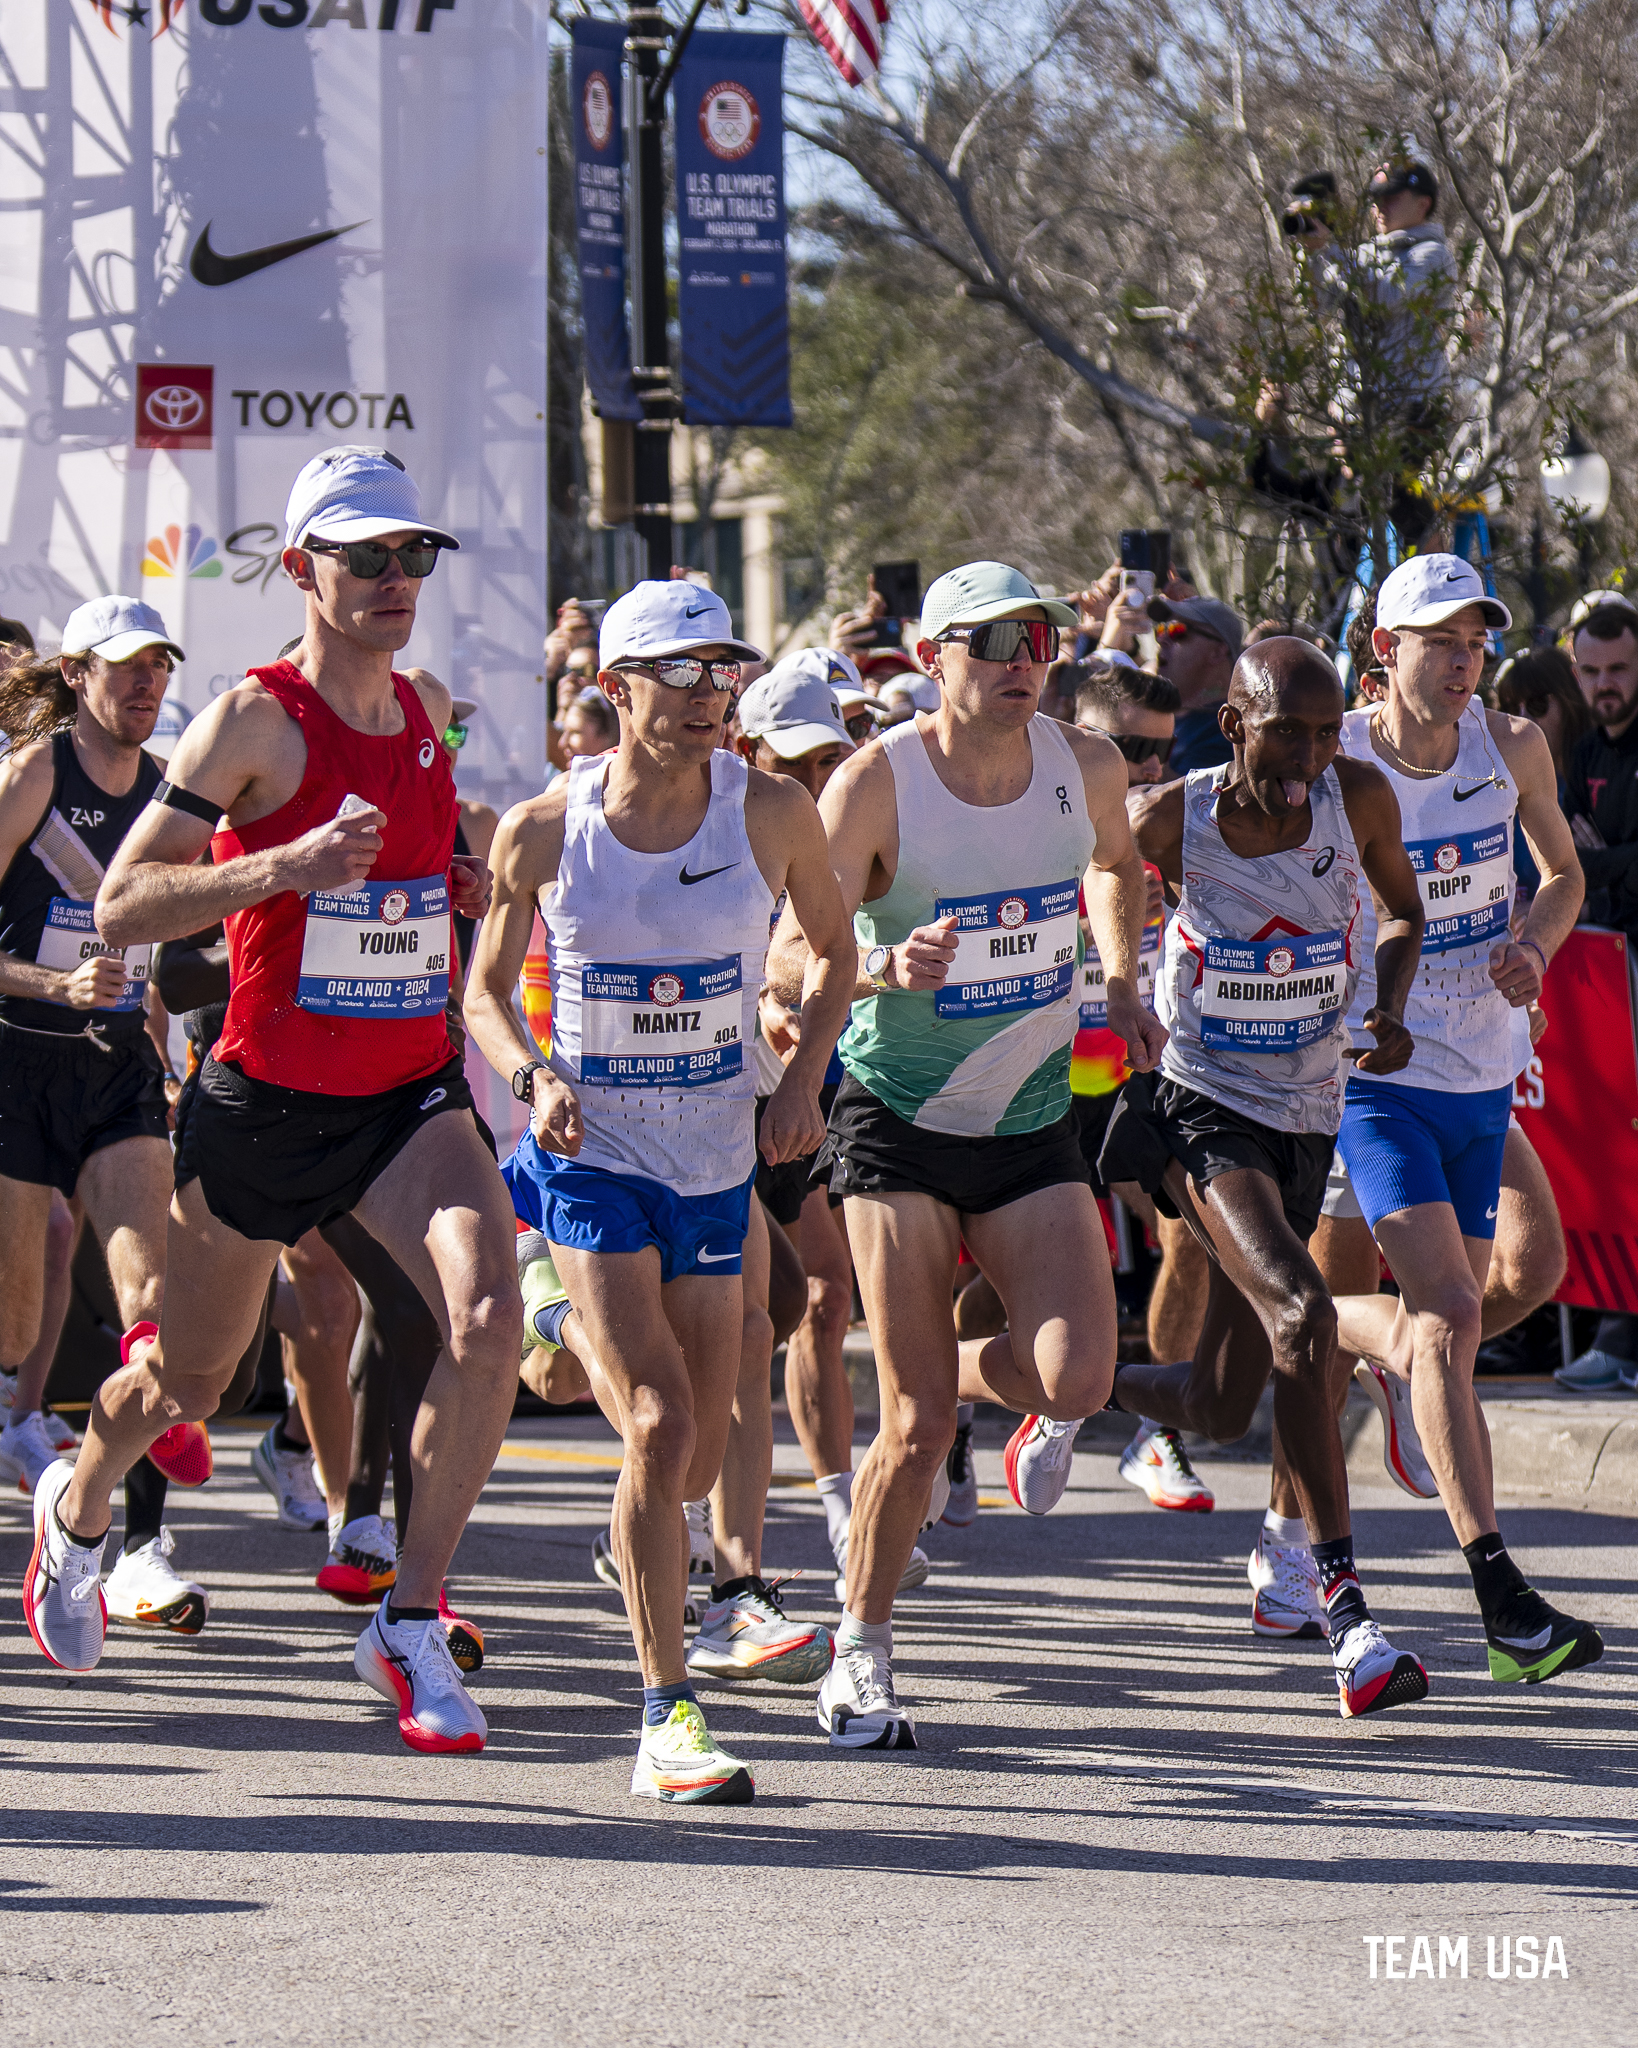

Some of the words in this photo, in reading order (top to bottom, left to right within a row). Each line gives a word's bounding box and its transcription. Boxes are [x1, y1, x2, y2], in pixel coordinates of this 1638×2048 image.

[686, 173, 713, 194] U.S.
[716, 173, 777, 196] OLYMPIC
[686, 196, 724, 218] TEAM
[728, 197, 777, 219] TRIALS
[705, 221, 758, 237] MARATHON
[231, 389, 415, 430] TOYOTA
[70, 806, 106, 828] ZAP
[1473, 832, 1504, 851] MARATHON
[421, 887, 447, 903] MARATHON
[1427, 874, 1472, 900] RUPP
[1488, 884, 1505, 901] 401
[314, 899, 339, 912] TEAM
[340, 902, 370, 915] TRIALS
[1041, 889, 1076, 907] MARATHON
[52, 905, 65, 916] U.S.
[66, 907, 93, 918] OLYMPIC
[940, 908, 954, 917] U.S.
[955, 904, 988, 916] OLYMPIC
[1470, 907, 1494, 927] 2024
[50, 914, 69, 926] TEAM
[69, 917, 92, 928] TRIALS
[962, 915, 988, 926] TRIALS
[359, 930, 419, 955] YOUNG
[989, 932, 1038, 959] RILEY
[1208, 945, 1222, 957] U.S.
[1223, 948, 1255, 959] OLYMPIC
[1306, 940, 1342, 956] MARATHON
[425, 953, 446, 972] 405
[1053, 945, 1073, 964] 402
[1208, 956, 1228, 967] TEAM
[1229, 959, 1255, 969] TRIALS
[132, 964, 145, 978] 421
[586, 972, 602, 983] U.S.
[603, 973, 638, 985] OLYMPIC
[699, 968, 738, 986] MARATHON
[327, 980, 393, 997] ORLANDO
[404, 978, 430, 997] 2024
[586, 983, 609, 995] TEAM
[610, 985, 638, 997] TRIALS
[962, 979, 1021, 1000] ORLANDO
[1033, 969, 1059, 990] 2024
[1217, 974, 1335, 1002] ABDIRAHMAN
[1318, 993, 1340, 1011] 403
[632, 1010, 702, 1034] MANTZ
[1226, 1021, 1286, 1036] ORLANDO
[1298, 1015, 1323, 1034] 2024
[713, 1024, 738, 1045] 404
[608, 1058, 675, 1074] ORLANDO
[689, 1050, 721, 1069] 2024
[340, 1543, 394, 1576] NITRO
